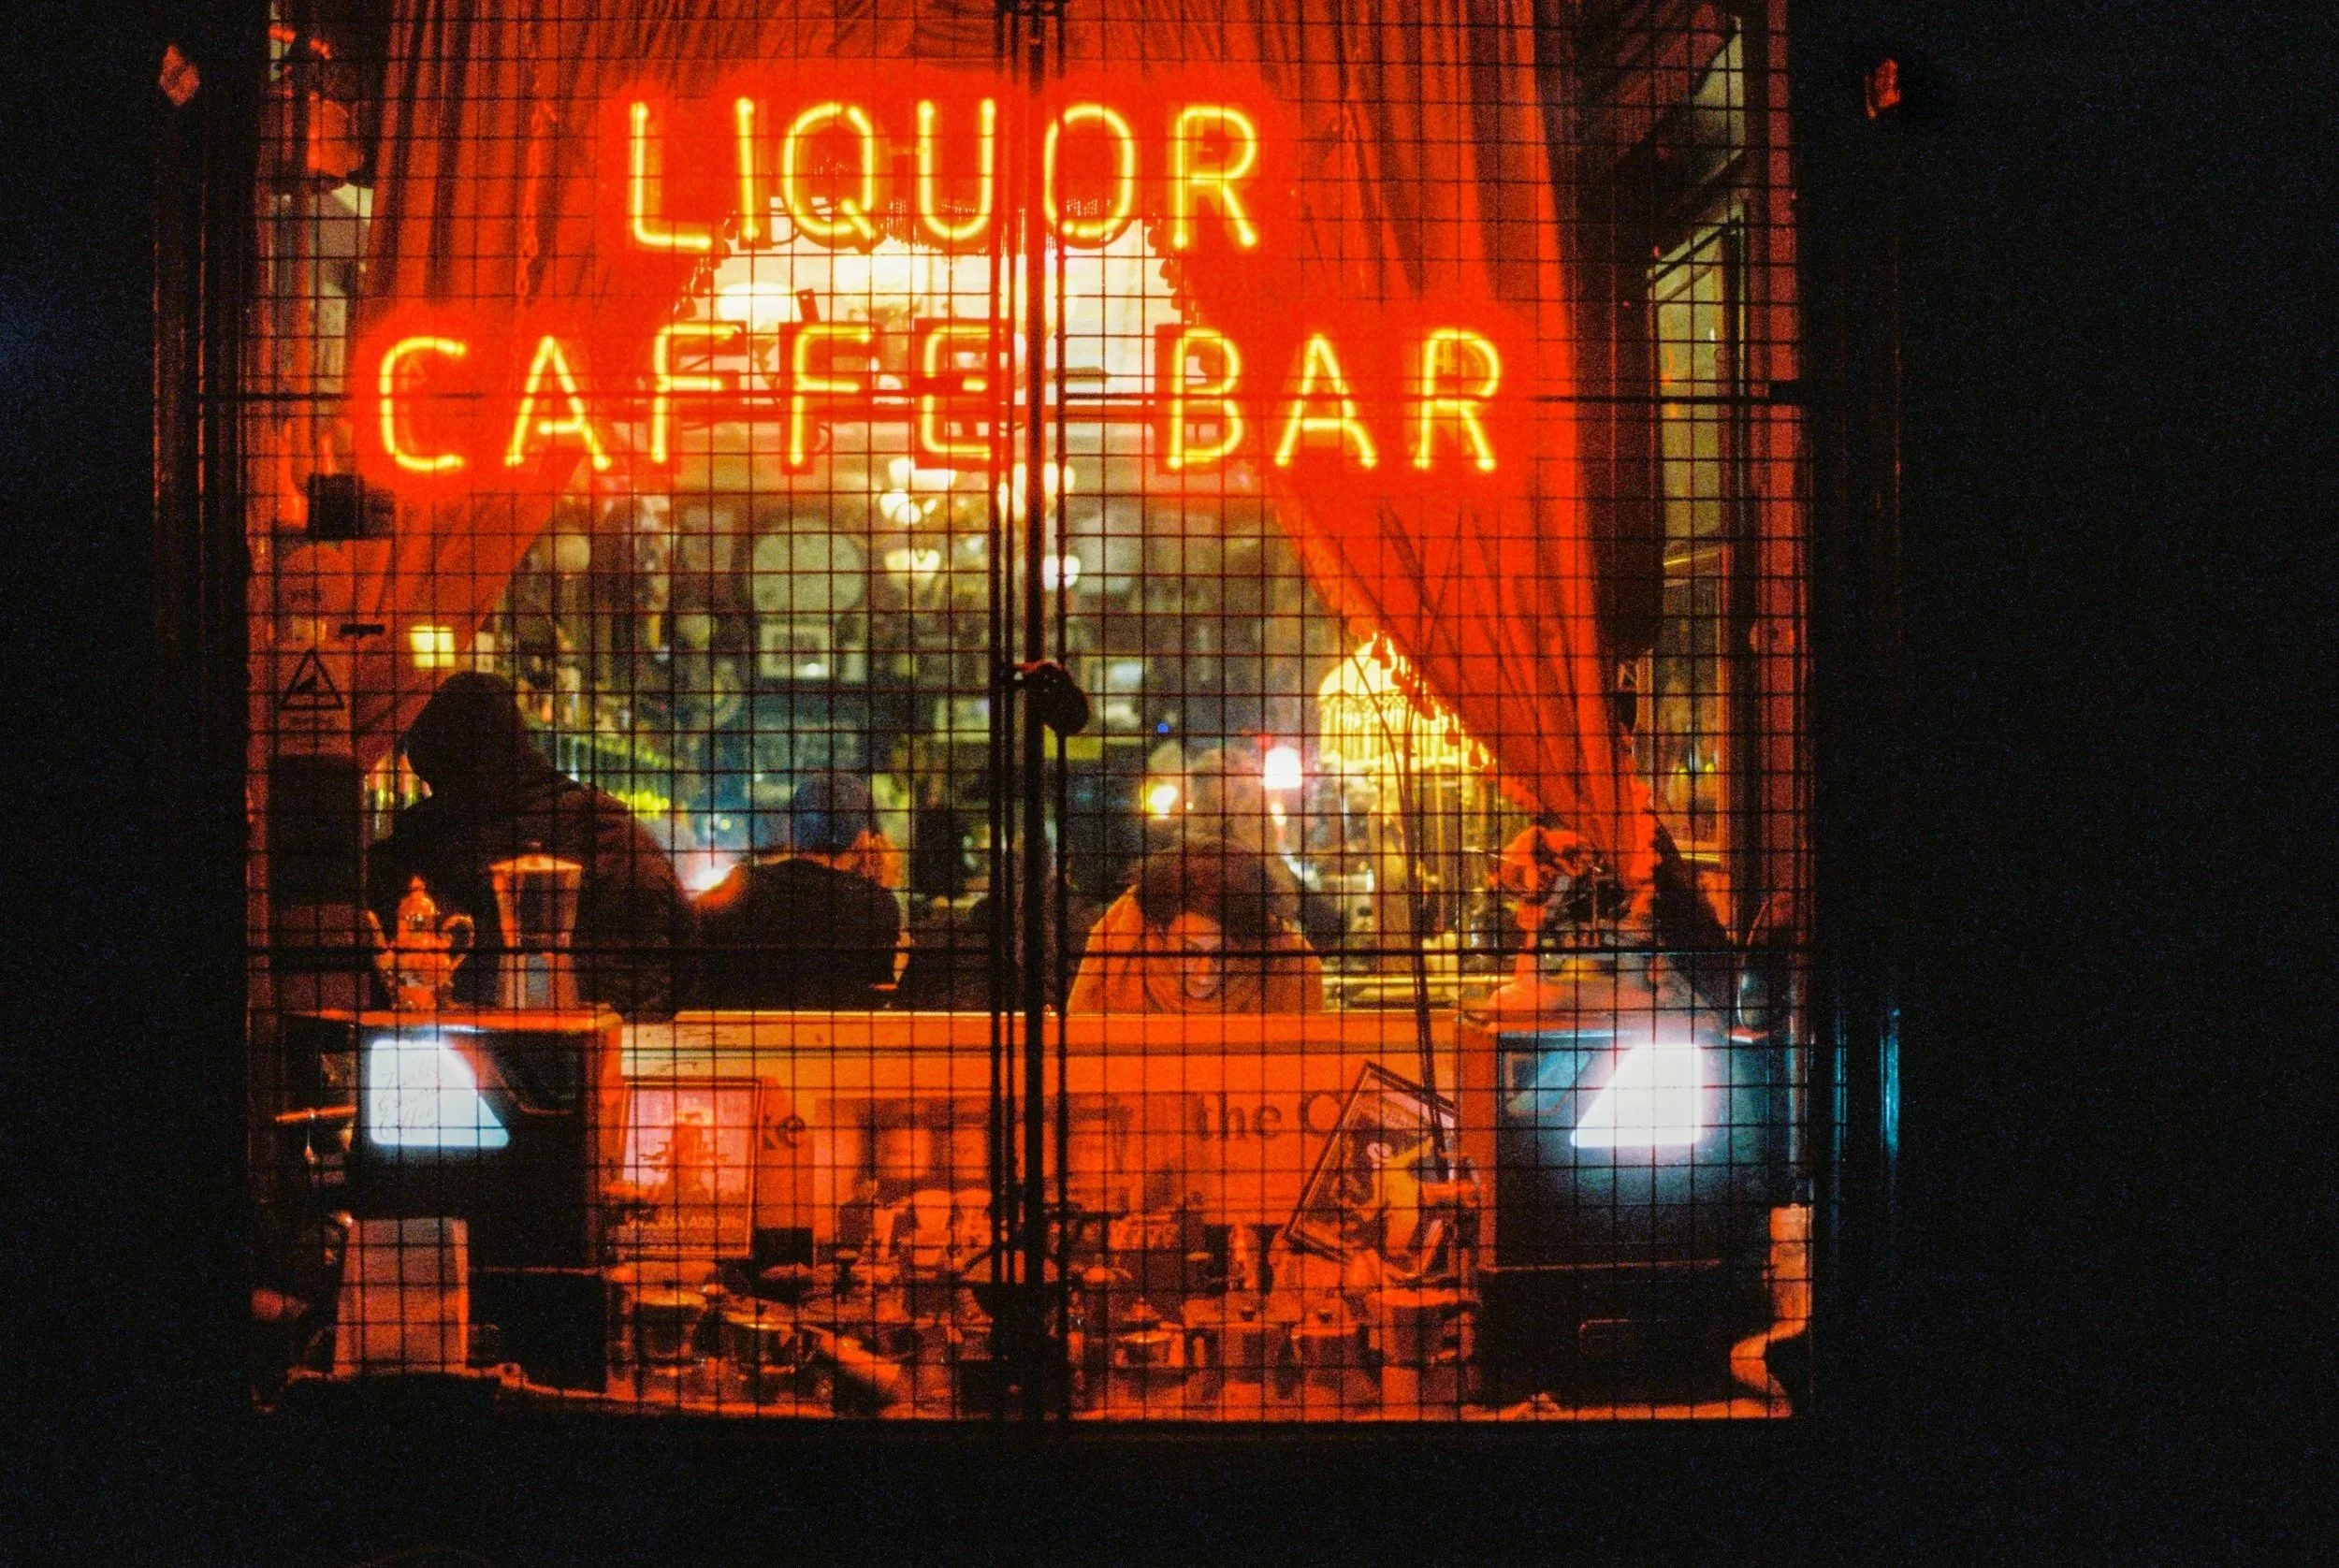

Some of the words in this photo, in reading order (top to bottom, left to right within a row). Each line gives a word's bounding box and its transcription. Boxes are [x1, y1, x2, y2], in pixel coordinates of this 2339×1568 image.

[630, 97, 1258, 251] LIQUOR
[378, 322, 994, 472] CAFFE
[1166, 327, 1501, 471] BAR
[1197, 1092, 1282, 1140] the
